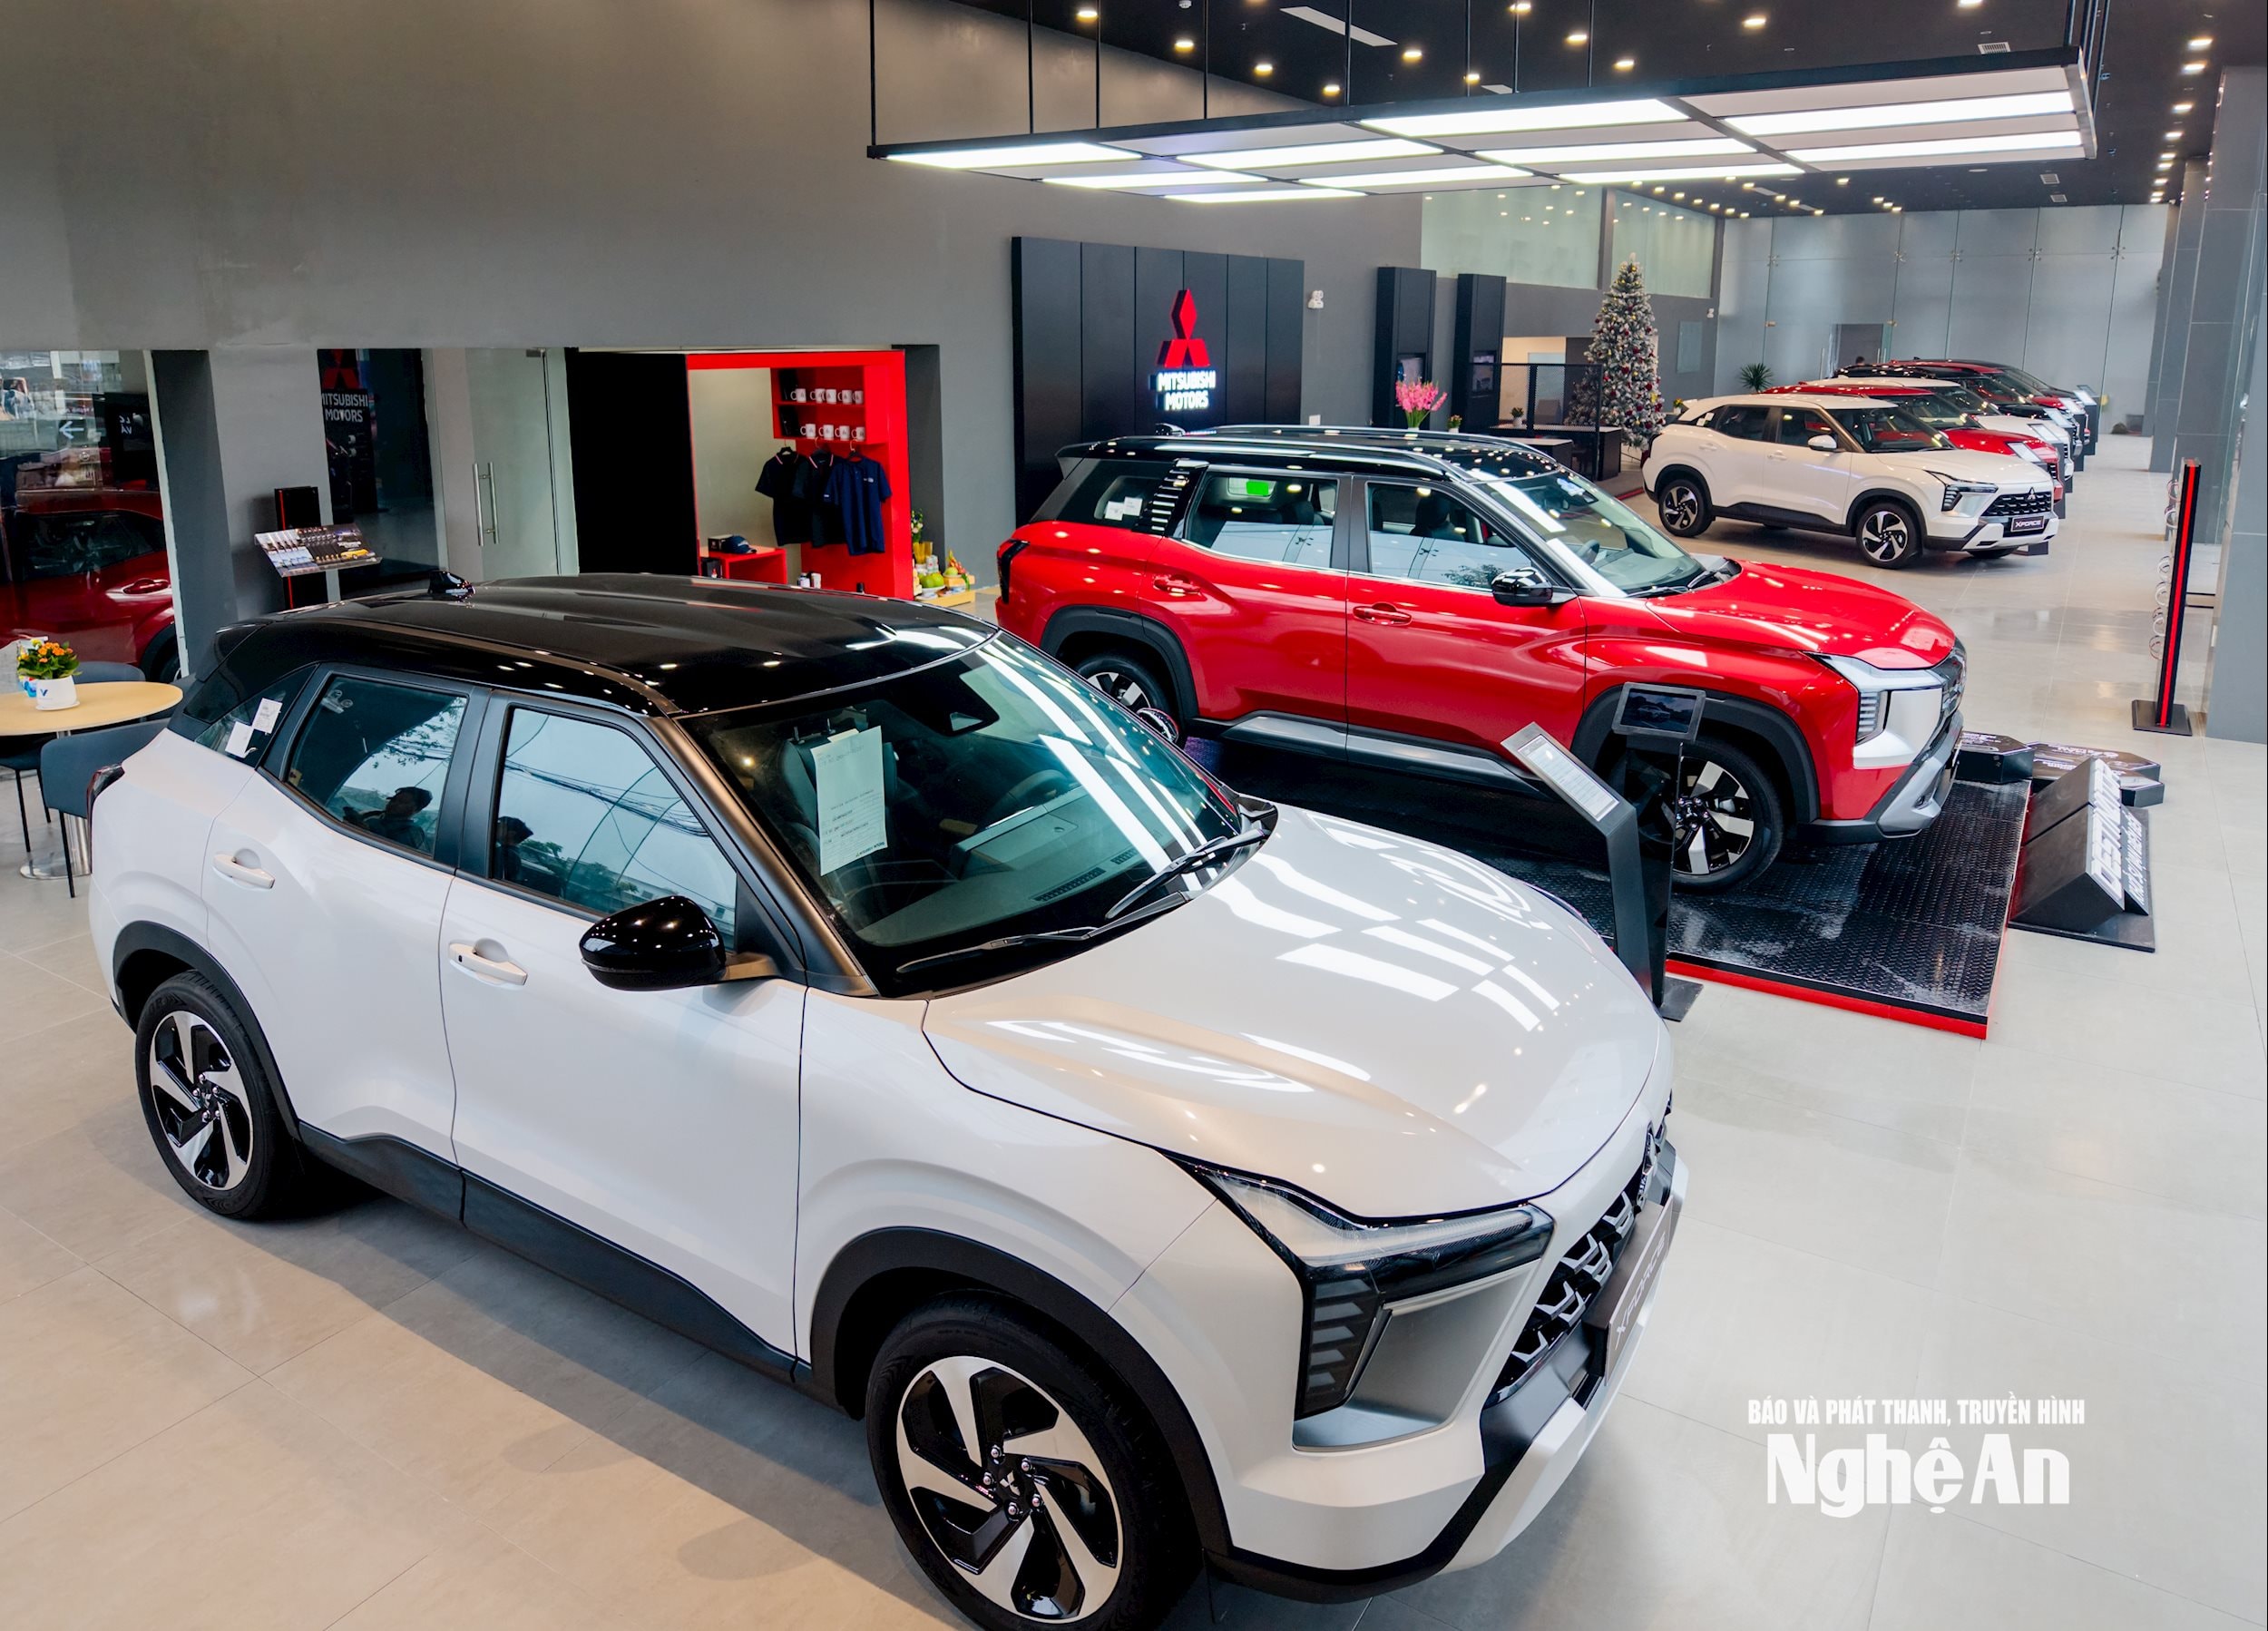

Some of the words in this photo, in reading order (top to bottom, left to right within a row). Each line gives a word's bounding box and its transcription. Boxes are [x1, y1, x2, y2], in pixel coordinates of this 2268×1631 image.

[1157, 370, 1217, 392] MITSUBISHI
[1164, 389, 1209, 411] MOTORS
[325, 408, 364, 423] MOTORS
[1614, 1230, 1667, 1351] XFORCE
